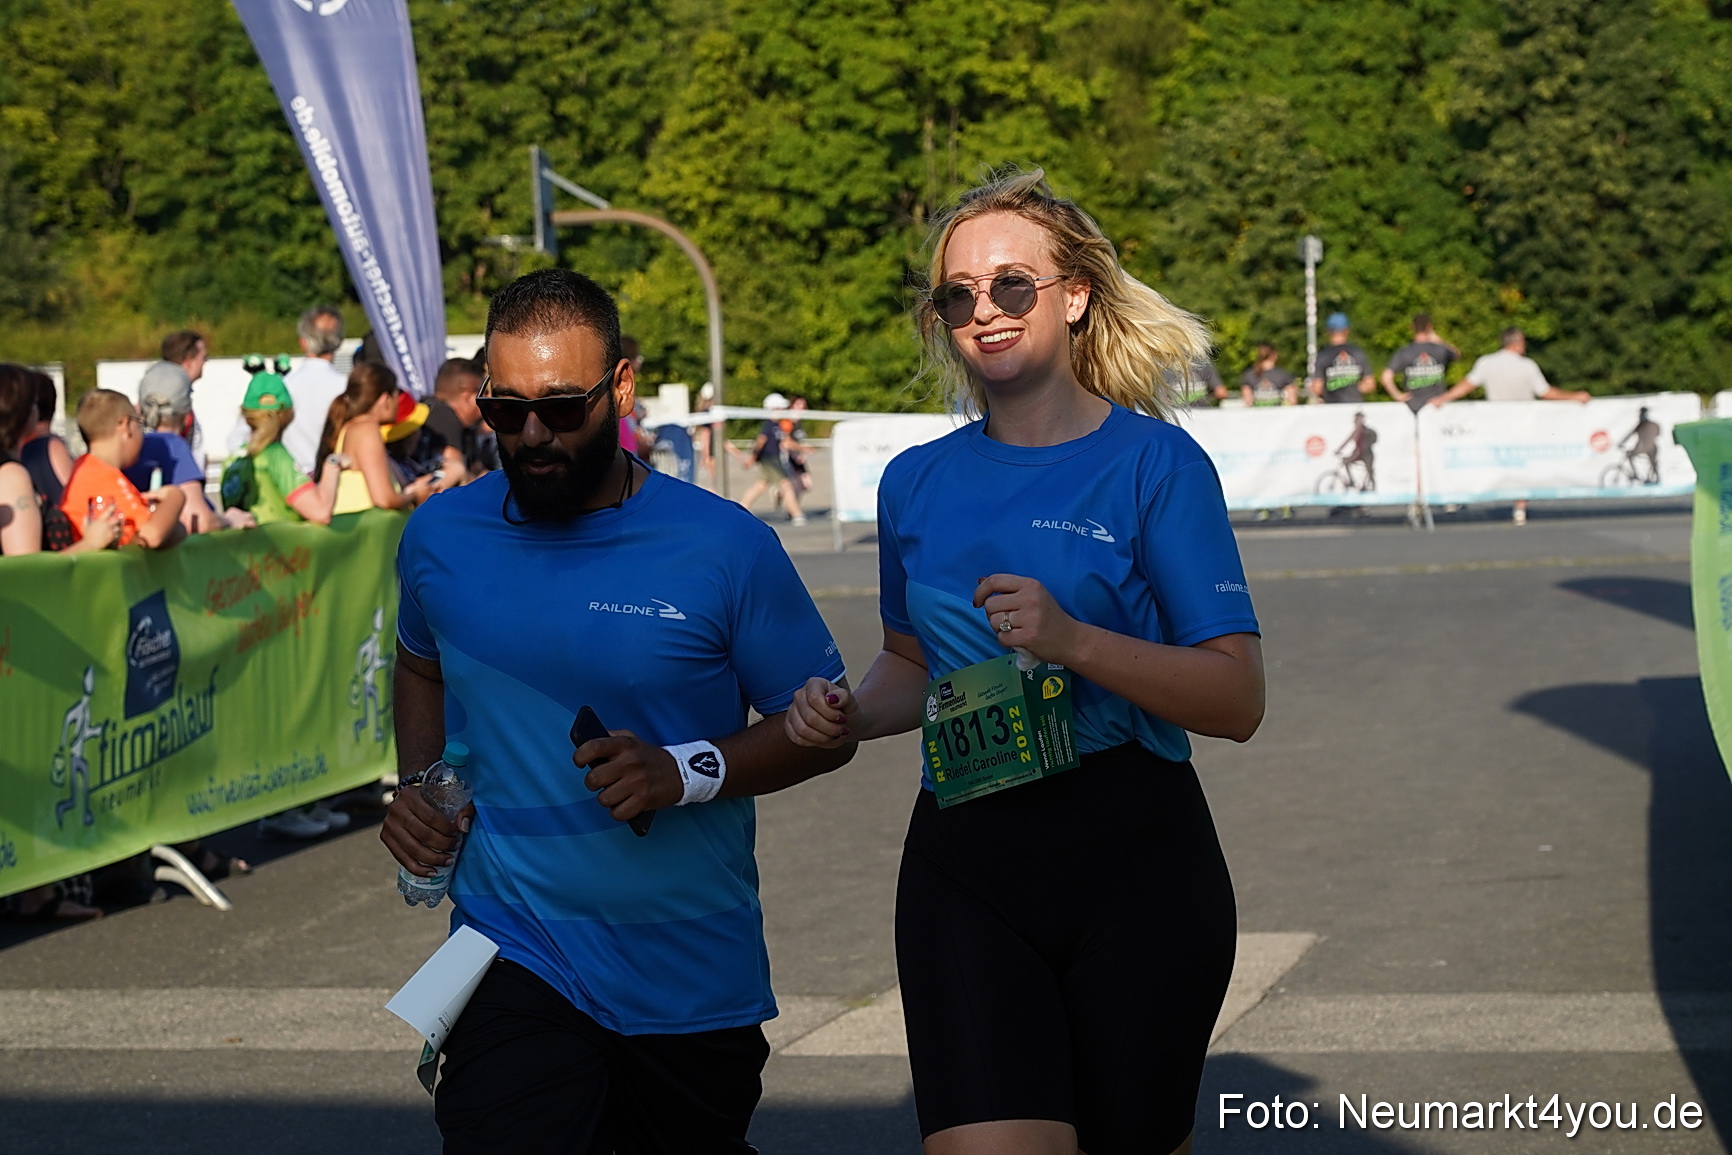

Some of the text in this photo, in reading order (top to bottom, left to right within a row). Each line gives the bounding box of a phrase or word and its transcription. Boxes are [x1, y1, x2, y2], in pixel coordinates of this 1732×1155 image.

[1031, 519, 1089, 537] RAILONE
[588, 601, 655, 617] RAILONE
[937, 705, 1011, 762] 1813
[1008, 705, 1032, 763] 2022
[928, 741, 946, 782] RUN
[945, 751, 1018, 781] Riedel Caroline
